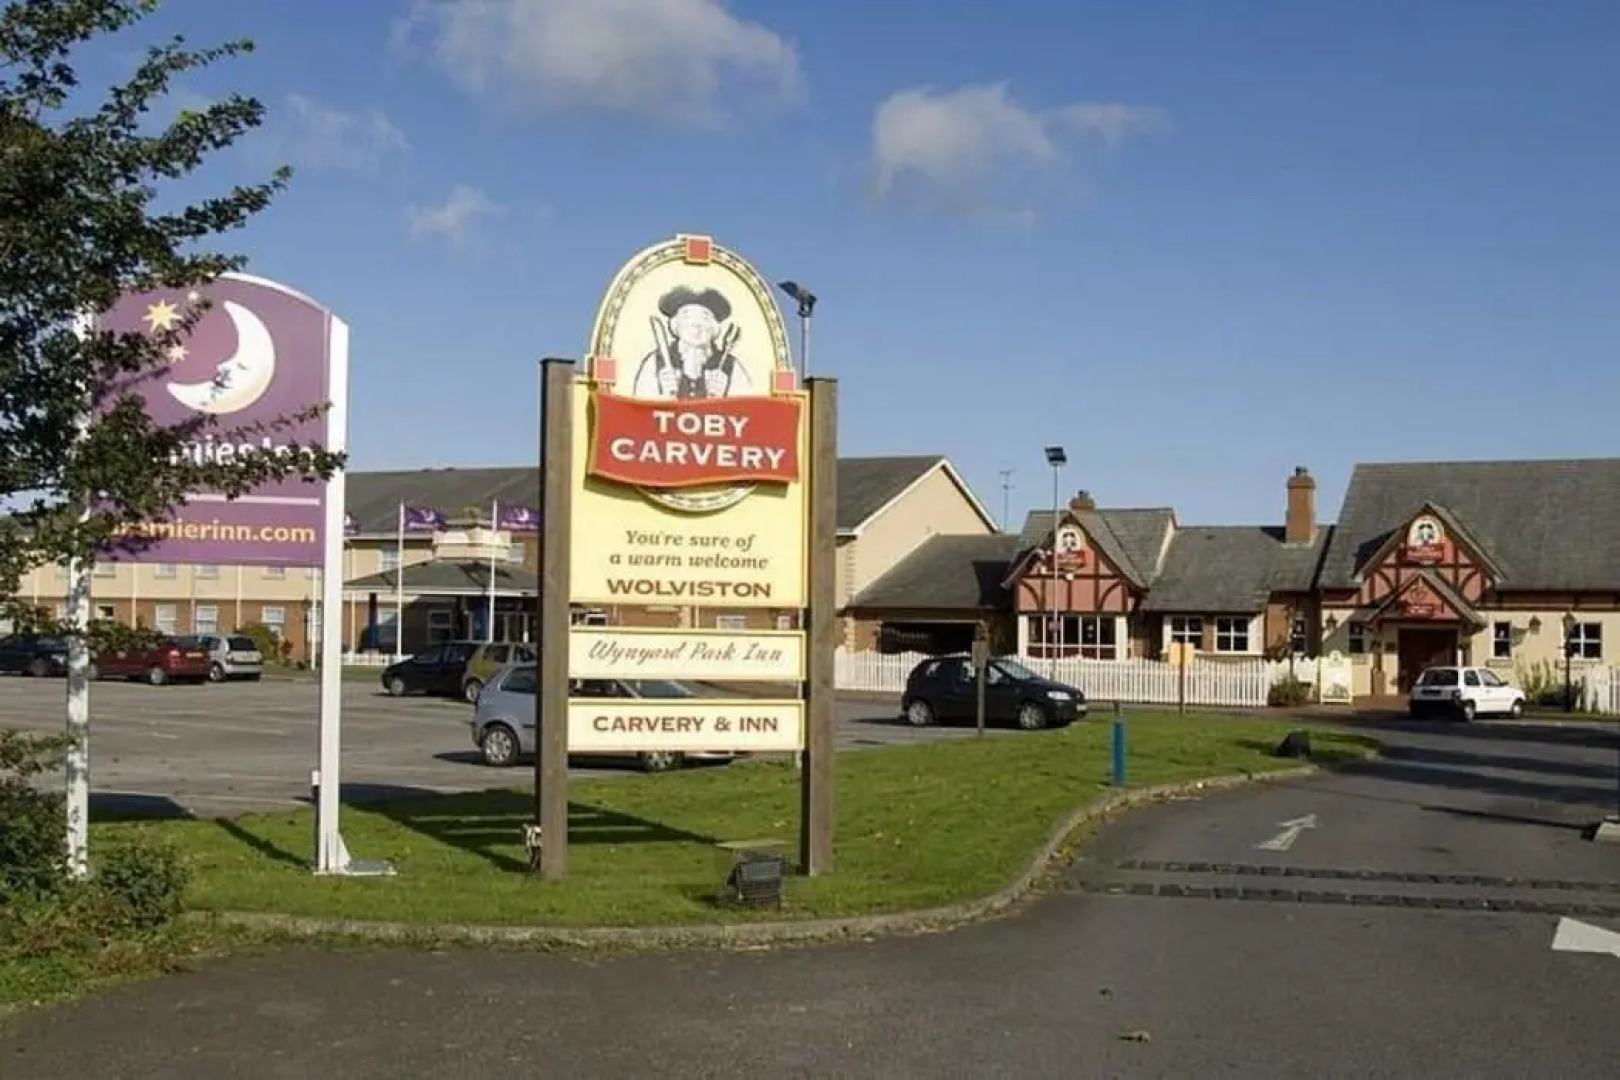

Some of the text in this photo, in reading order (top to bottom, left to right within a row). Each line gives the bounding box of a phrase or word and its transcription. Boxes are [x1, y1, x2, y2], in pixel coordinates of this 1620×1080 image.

[653, 410, 749, 438] TOBY
[610, 437, 786, 469] CARVERY
[625, 530, 756, 551] You're sure of
[609, 553, 769, 570] a warm welcome
[607, 578, 772, 598] WOLVISTON
[588, 639, 783, 665] Wynyard Park Inn
[592, 716, 779, 732] CARVERY & INN
